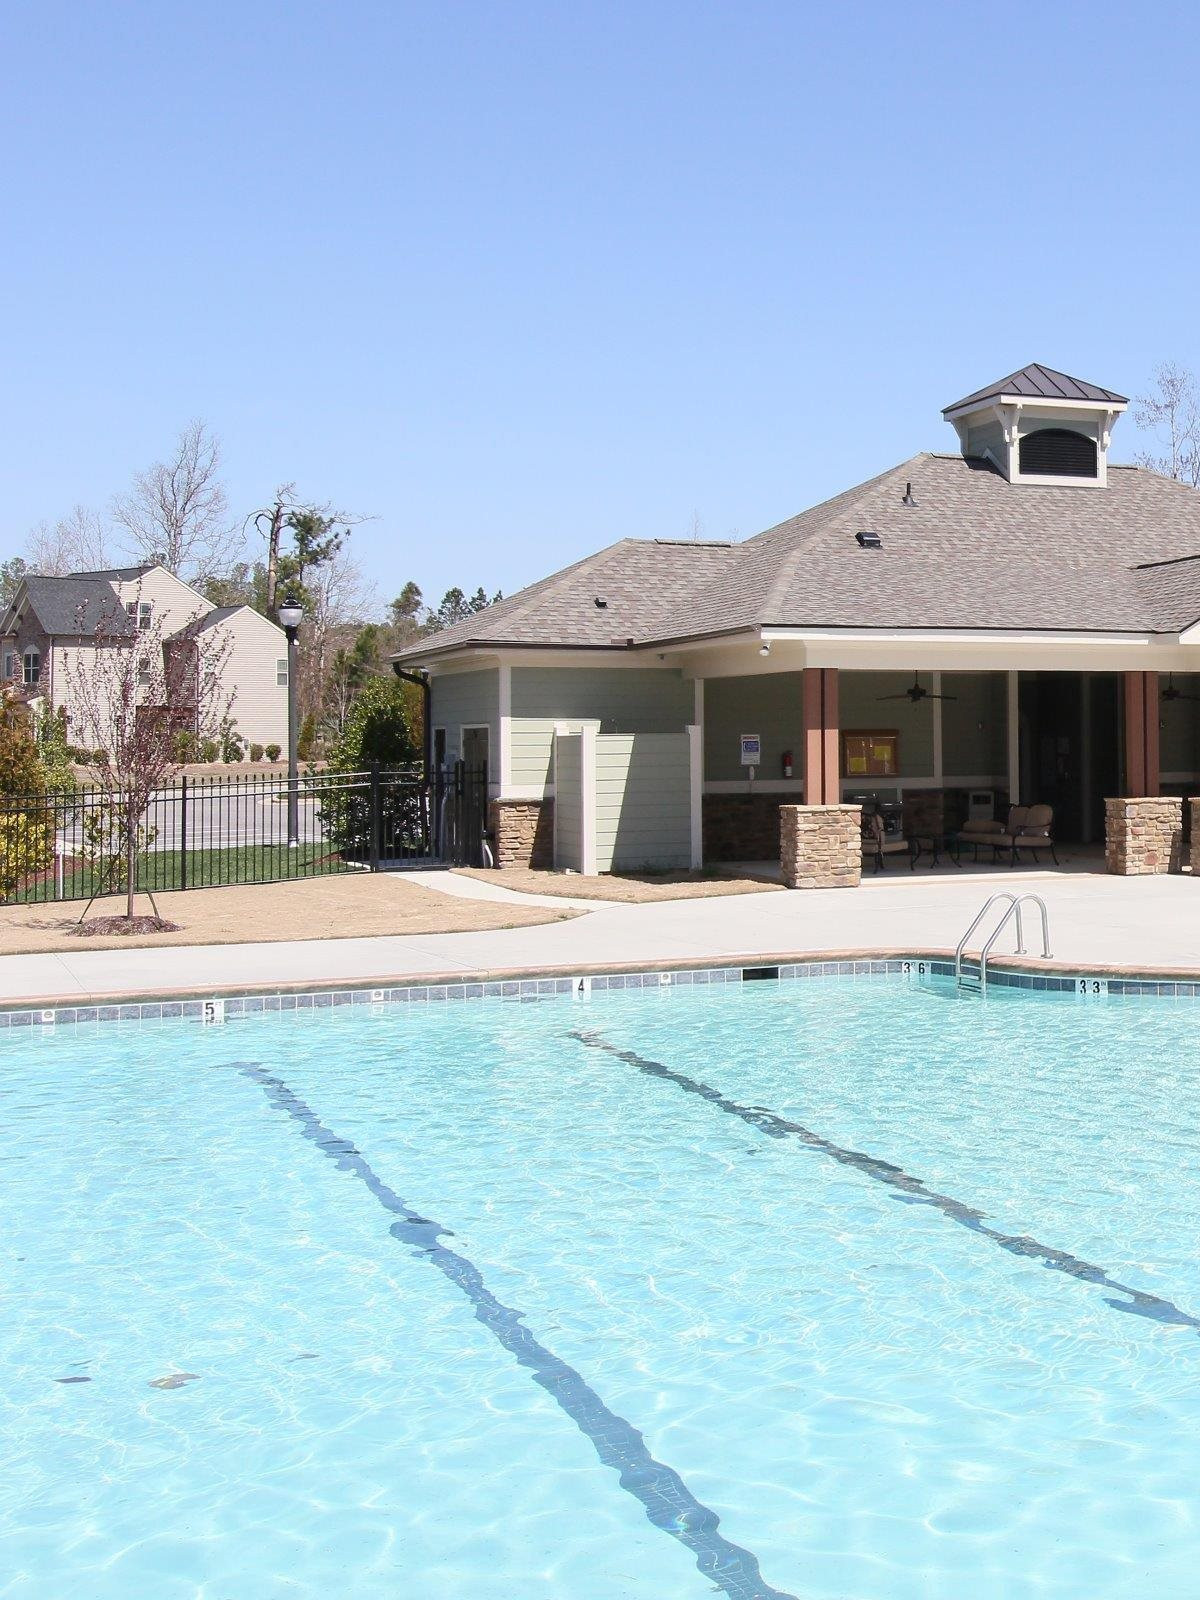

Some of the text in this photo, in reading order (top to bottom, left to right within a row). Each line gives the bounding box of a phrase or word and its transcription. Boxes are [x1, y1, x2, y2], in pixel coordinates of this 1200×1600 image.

[903, 962, 911, 974] 3
[918, 962, 925, 974] 6
[578, 977, 585, 991] 4
[1080, 980, 1087, 994] 3
[1092, 981, 1100, 993] 3
[205, 1002, 215, 1015] 5
